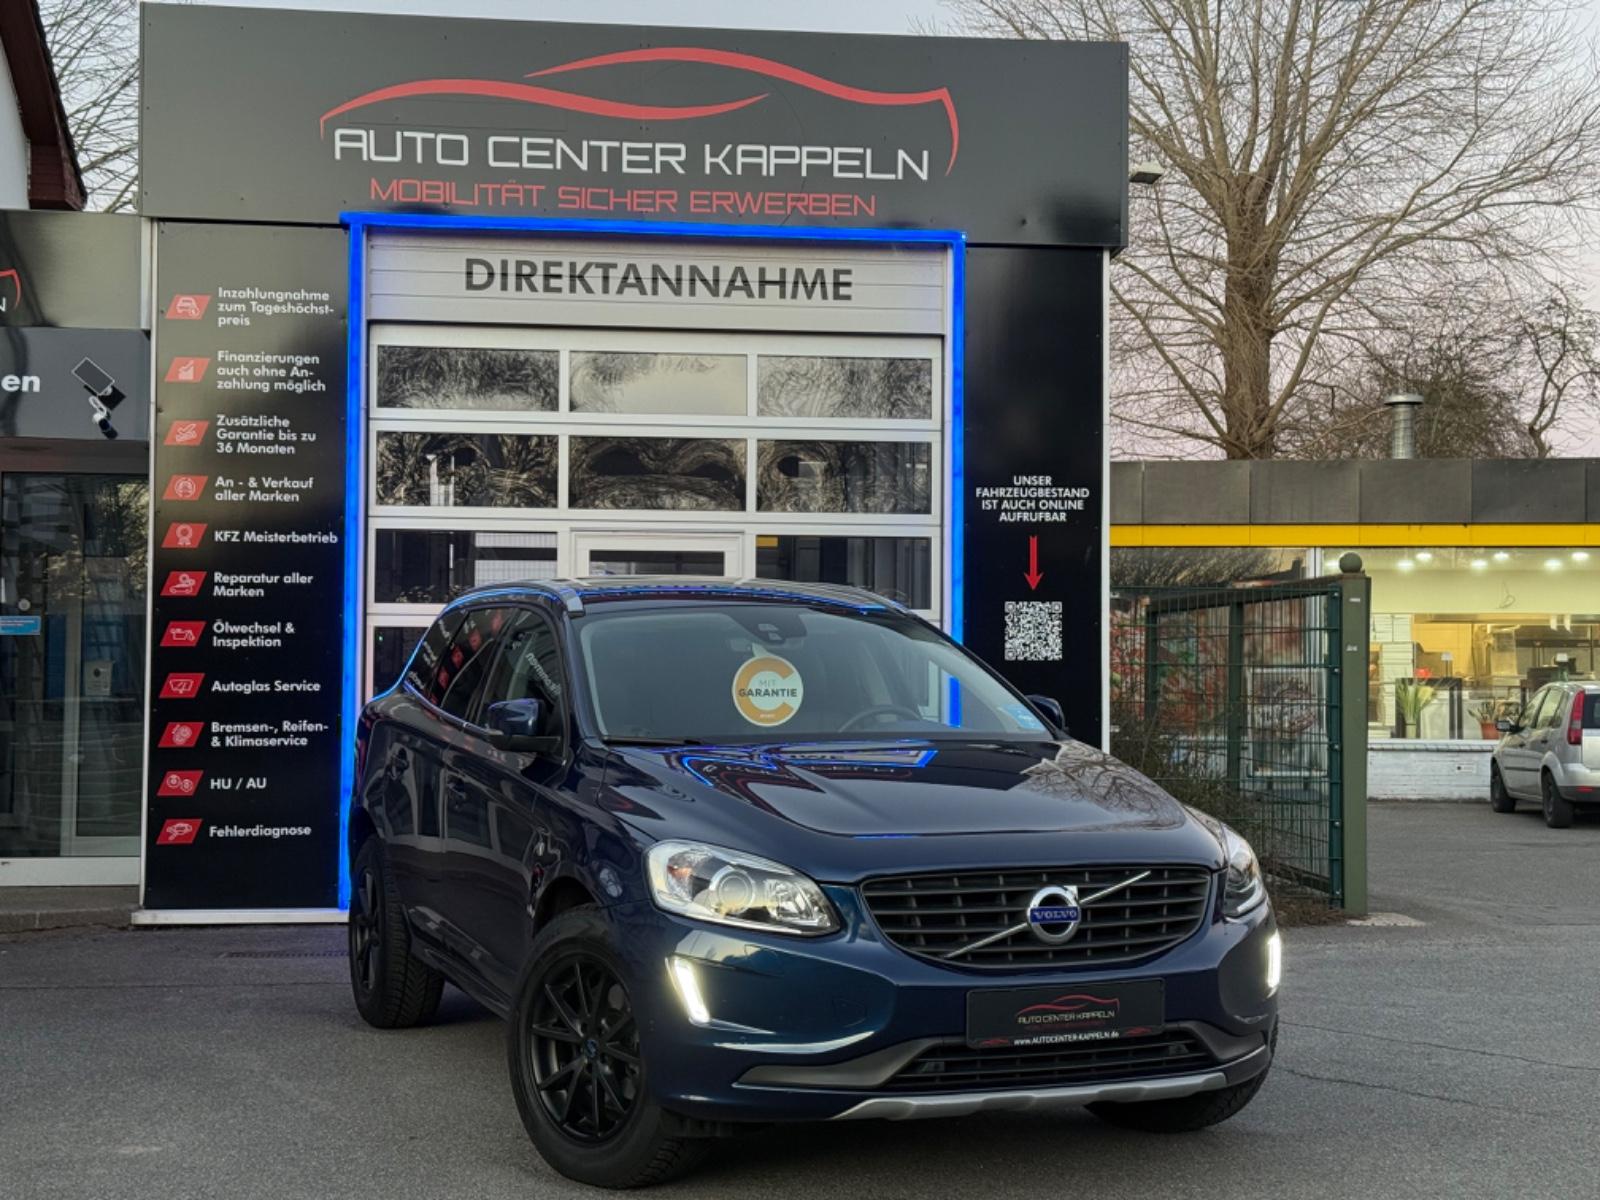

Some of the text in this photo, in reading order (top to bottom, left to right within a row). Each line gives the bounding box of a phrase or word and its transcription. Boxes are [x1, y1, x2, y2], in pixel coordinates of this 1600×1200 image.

[334, 128, 929, 180] AUTO CENTER KAPPELN
[370, 178, 876, 216] MOBILITÄT SICHER ERWERBEN
[466, 258, 853, 301] DIREKTANNAHME
[218, 287, 330, 302] Inzahlungnahme
[218, 301, 334, 315] zum Tageshöchst-
[218, 314, 250, 328] preis
[217, 351, 320, 366] Finanzierungen
[216, 365, 315, 378] auch ohne An-
[1, 374, 41, 392] en
[216, 379, 326, 394] zahlung möglich
[216, 414, 290, 428] Zusätzliche
[216, 429, 316, 442] Garantie bis zu
[216, 442, 296, 455] 36 Monaten
[215, 476, 234, 488] An
[248, 477, 258, 488] &
[262, 477, 314, 489] Verkauf
[1014, 475, 1052, 486] UNSER
[215, 490, 300, 502] aller Marken
[976, 488, 1090, 498] FAHRZEUGBESTAND
[982, 500, 1084, 510] IST AUCH ONLINE
[999, 512, 1067, 522] AUFRUFBAR
[214, 530, 338, 544] KFZ Meisterbetrieb
[214, 572, 314, 585] Reparatur aller
[213, 586, 264, 597] Marken
[213, 618, 295, 634] Ölwechsel &
[213, 636, 282, 650] Inspektion
[212, 680, 321, 694] Autoglas Service
[760, 680, 776, 688] MIT
[738, 688, 798, 698] GARANTIE
[211, 720, 329, 734] Bremsen-, Reifen-
[211, 735, 308, 748] & Klimaservice
[210, 778, 267, 790] HU / AU
[210, 825, 312, 838] Fehlerdiagnose
[1033, 909, 1078, 919] VOLVO
[1018, 1010, 1115, 1024] AUTO CENTER KAPPELN
[1014, 1031, 1120, 1046] www.AUTOCENTER-KAPPELN.de
